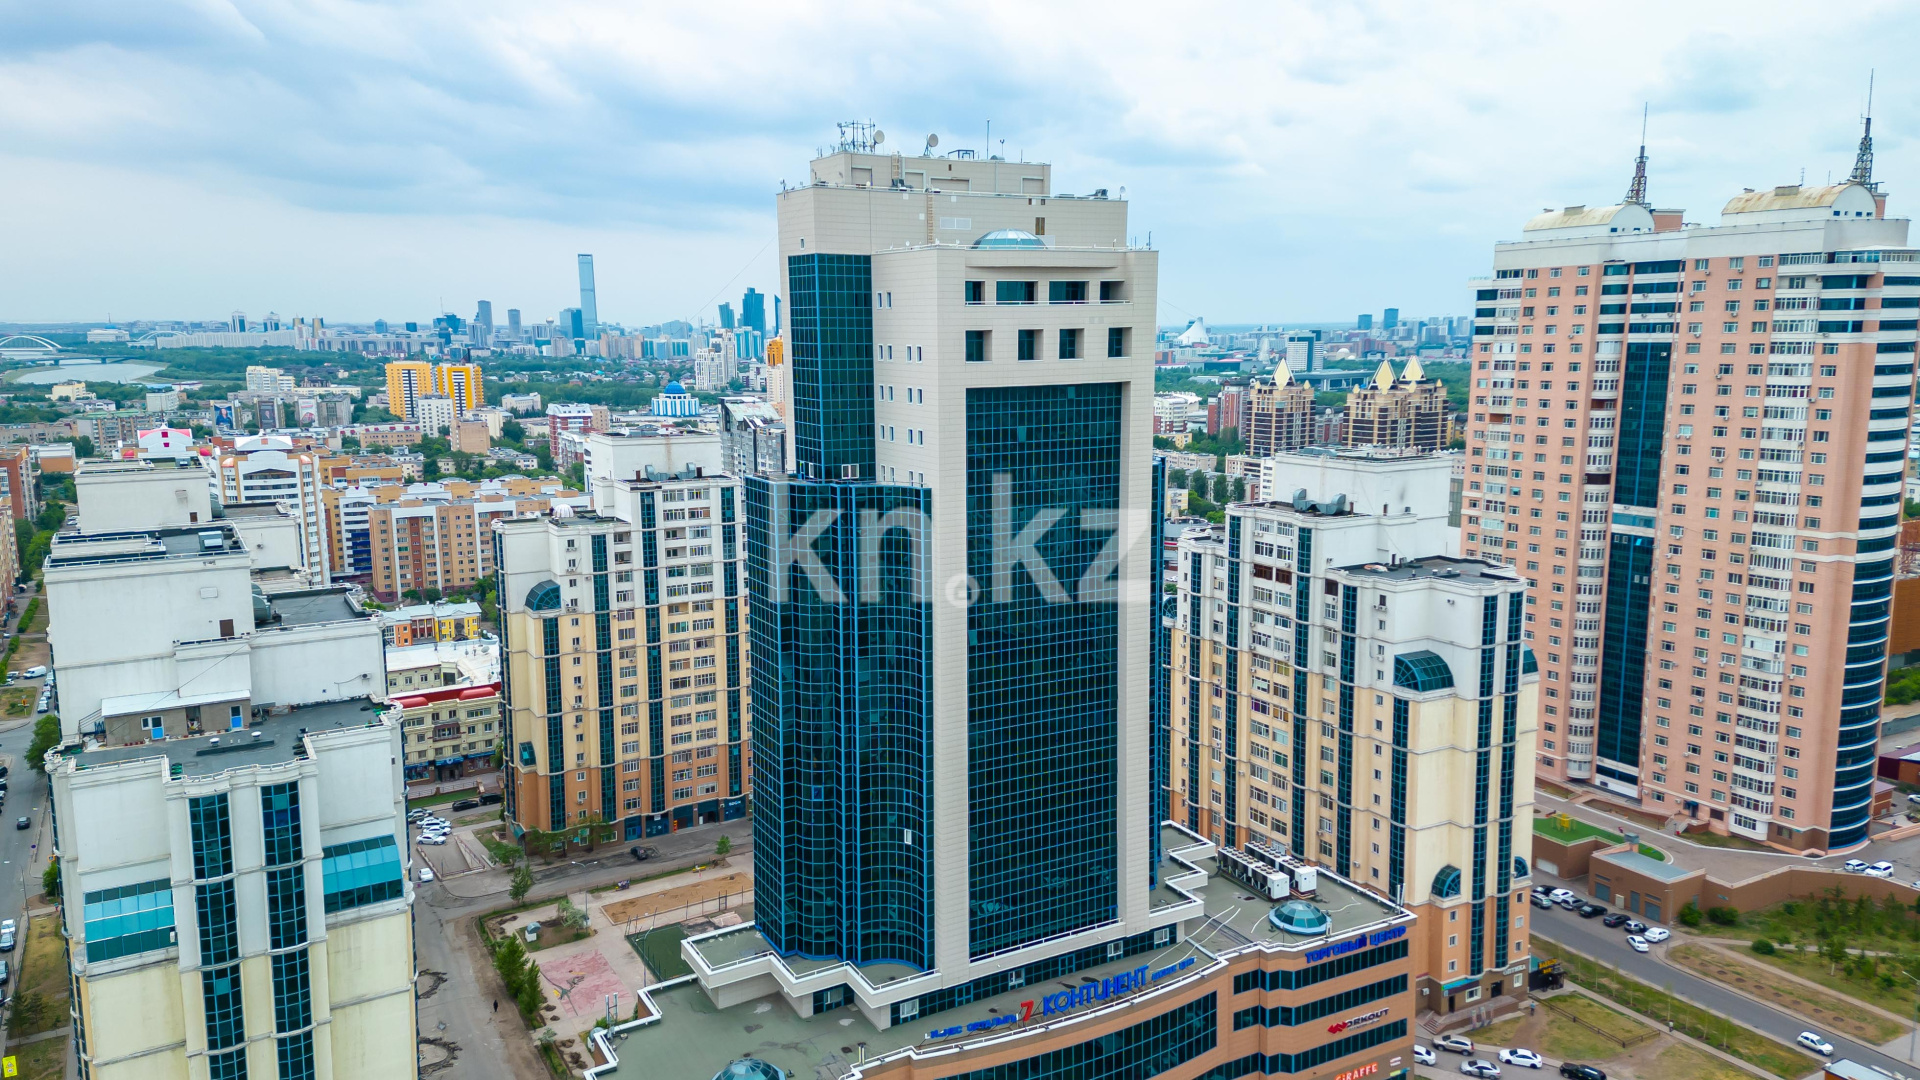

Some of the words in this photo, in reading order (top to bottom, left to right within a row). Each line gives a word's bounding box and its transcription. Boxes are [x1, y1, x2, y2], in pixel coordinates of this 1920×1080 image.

[1305, 934, 1367, 963] ТОРГОВЫЙ
[1369, 925, 1406, 946] ЦЕНТР
[1020, 1000, 1034, 1022] 7
[1043, 964, 1149, 1016] КОНТИНЕНТ
